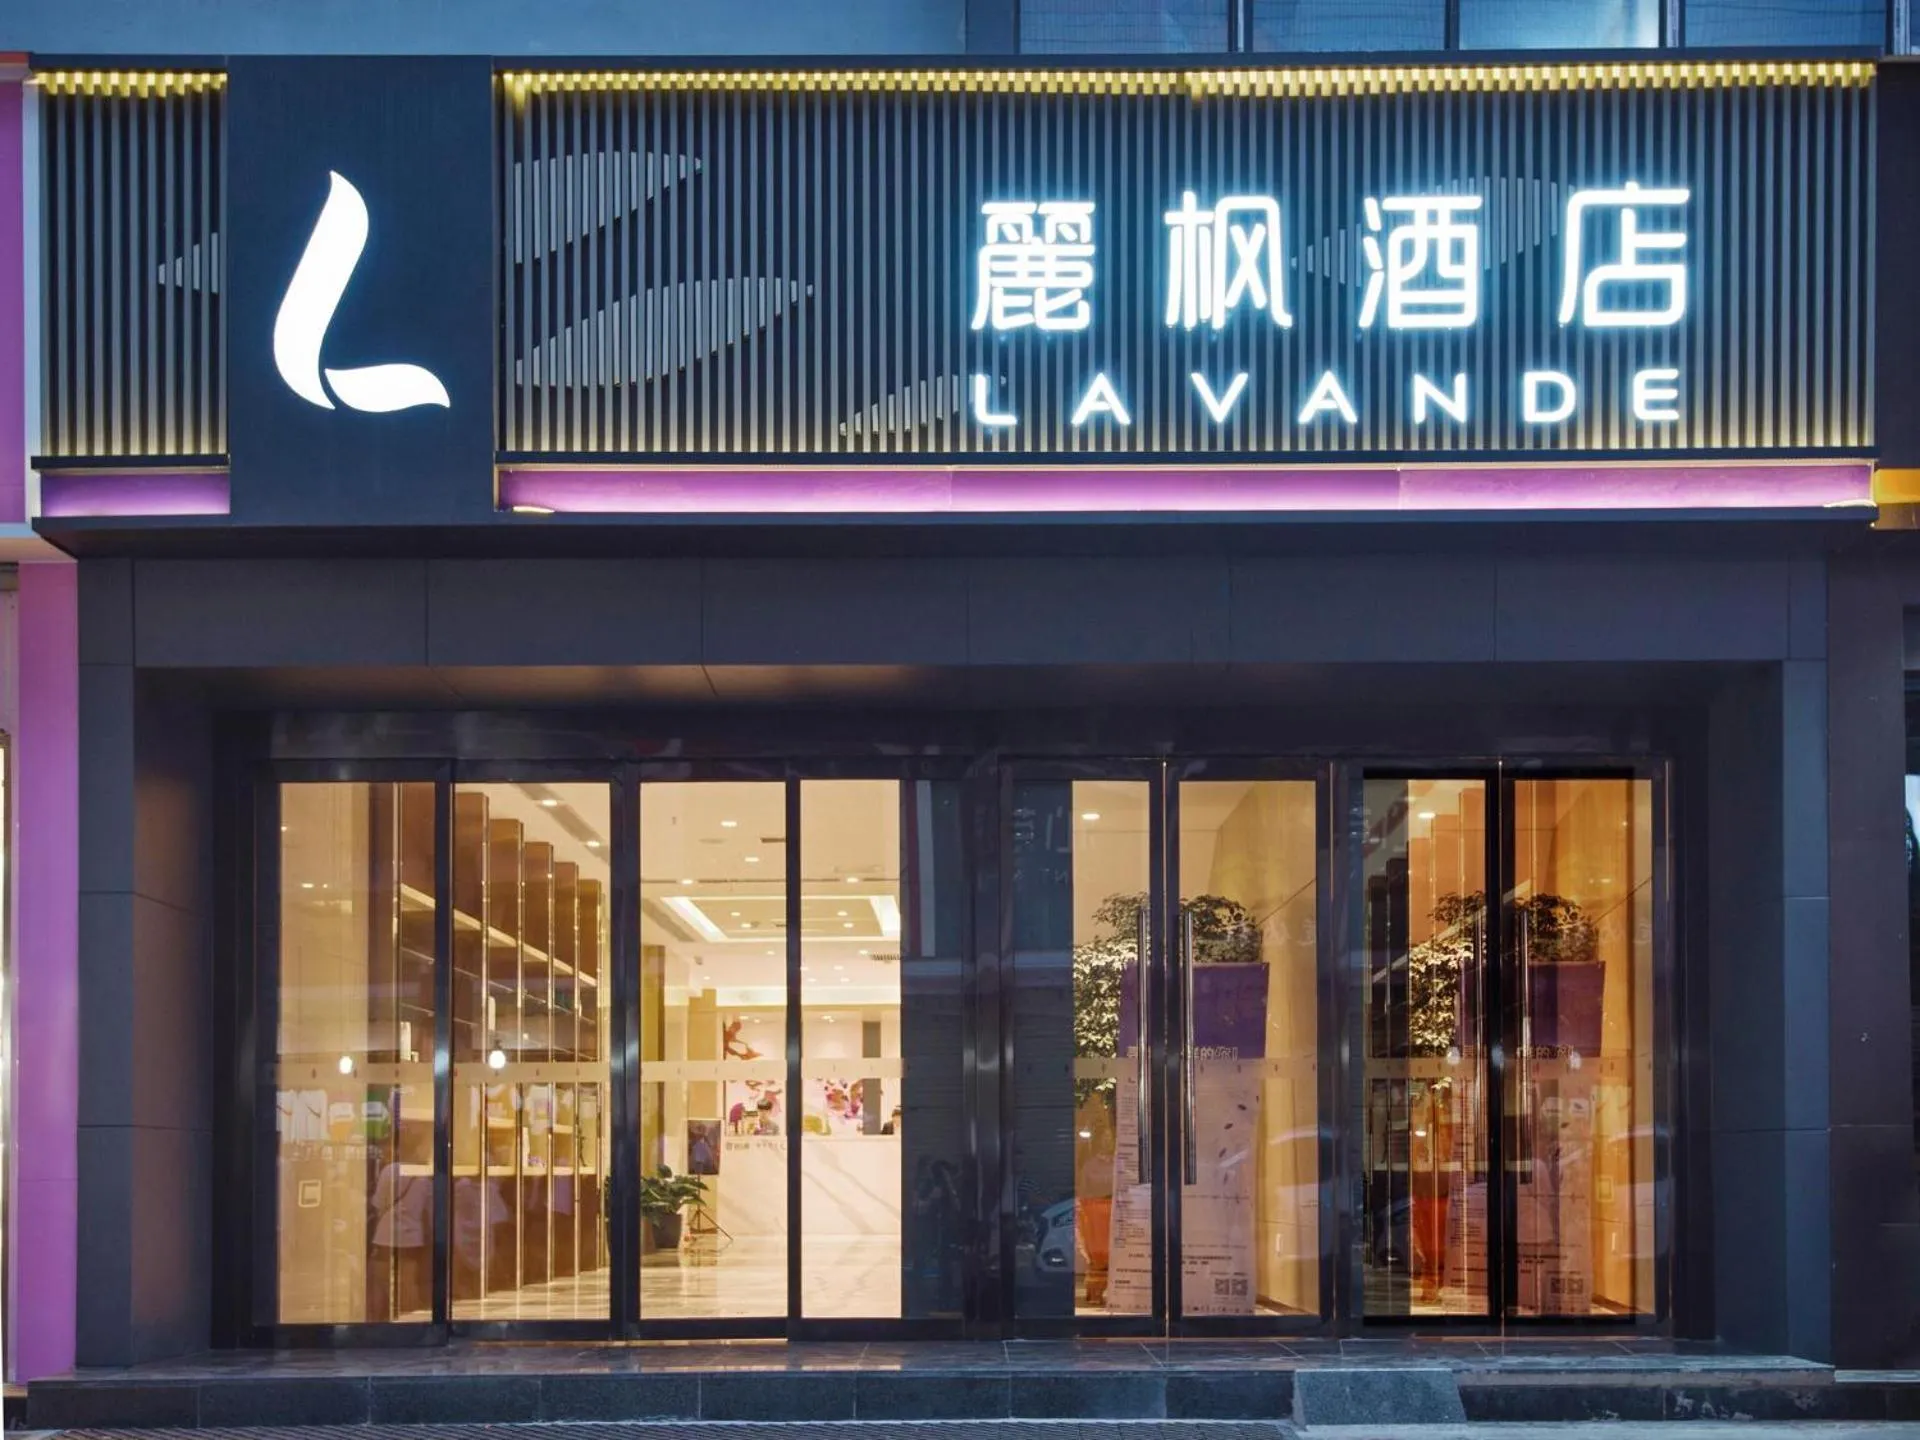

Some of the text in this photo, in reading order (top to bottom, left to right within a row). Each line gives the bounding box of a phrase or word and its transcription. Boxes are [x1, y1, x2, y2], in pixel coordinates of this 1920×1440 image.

[971, 181, 1691, 330] 麗枫酒店
[973, 368, 1681, 427] LAVANDE
